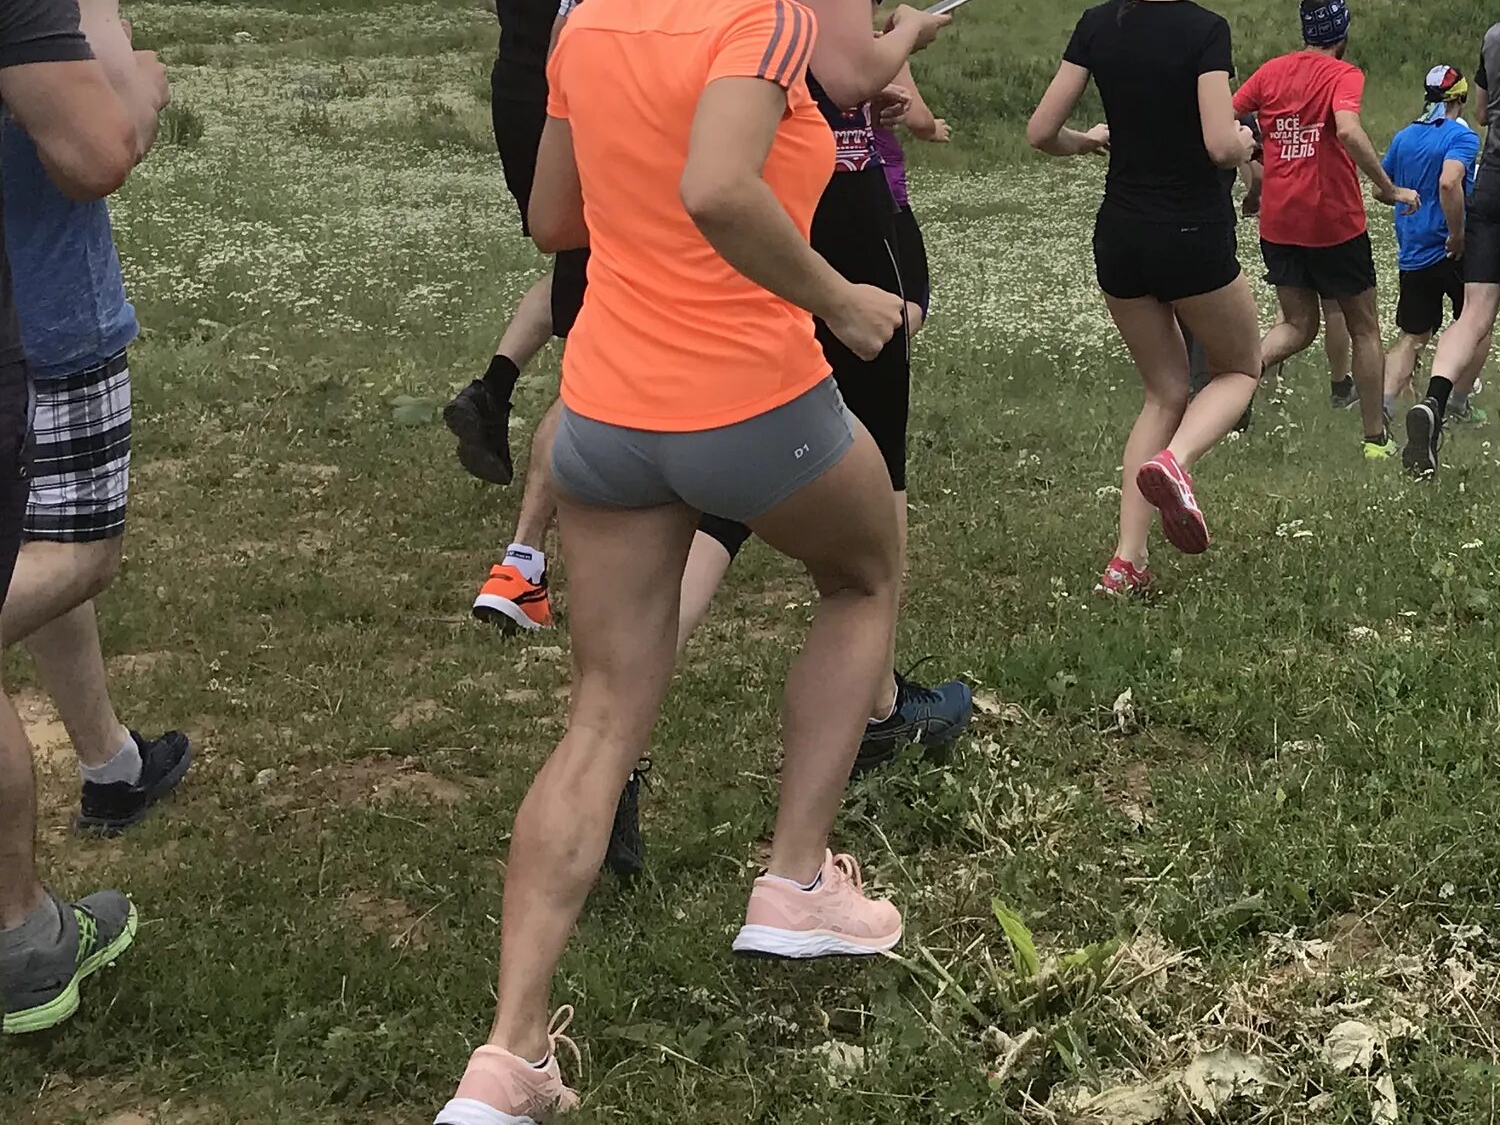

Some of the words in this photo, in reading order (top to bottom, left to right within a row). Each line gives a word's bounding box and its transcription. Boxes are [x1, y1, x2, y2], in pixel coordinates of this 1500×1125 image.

[1276, 114, 1300, 131] ВСЁ
[1292, 128, 1320, 144] ЕСТЬ
[1280, 143, 1315, 161] ЦЕЛЬ
